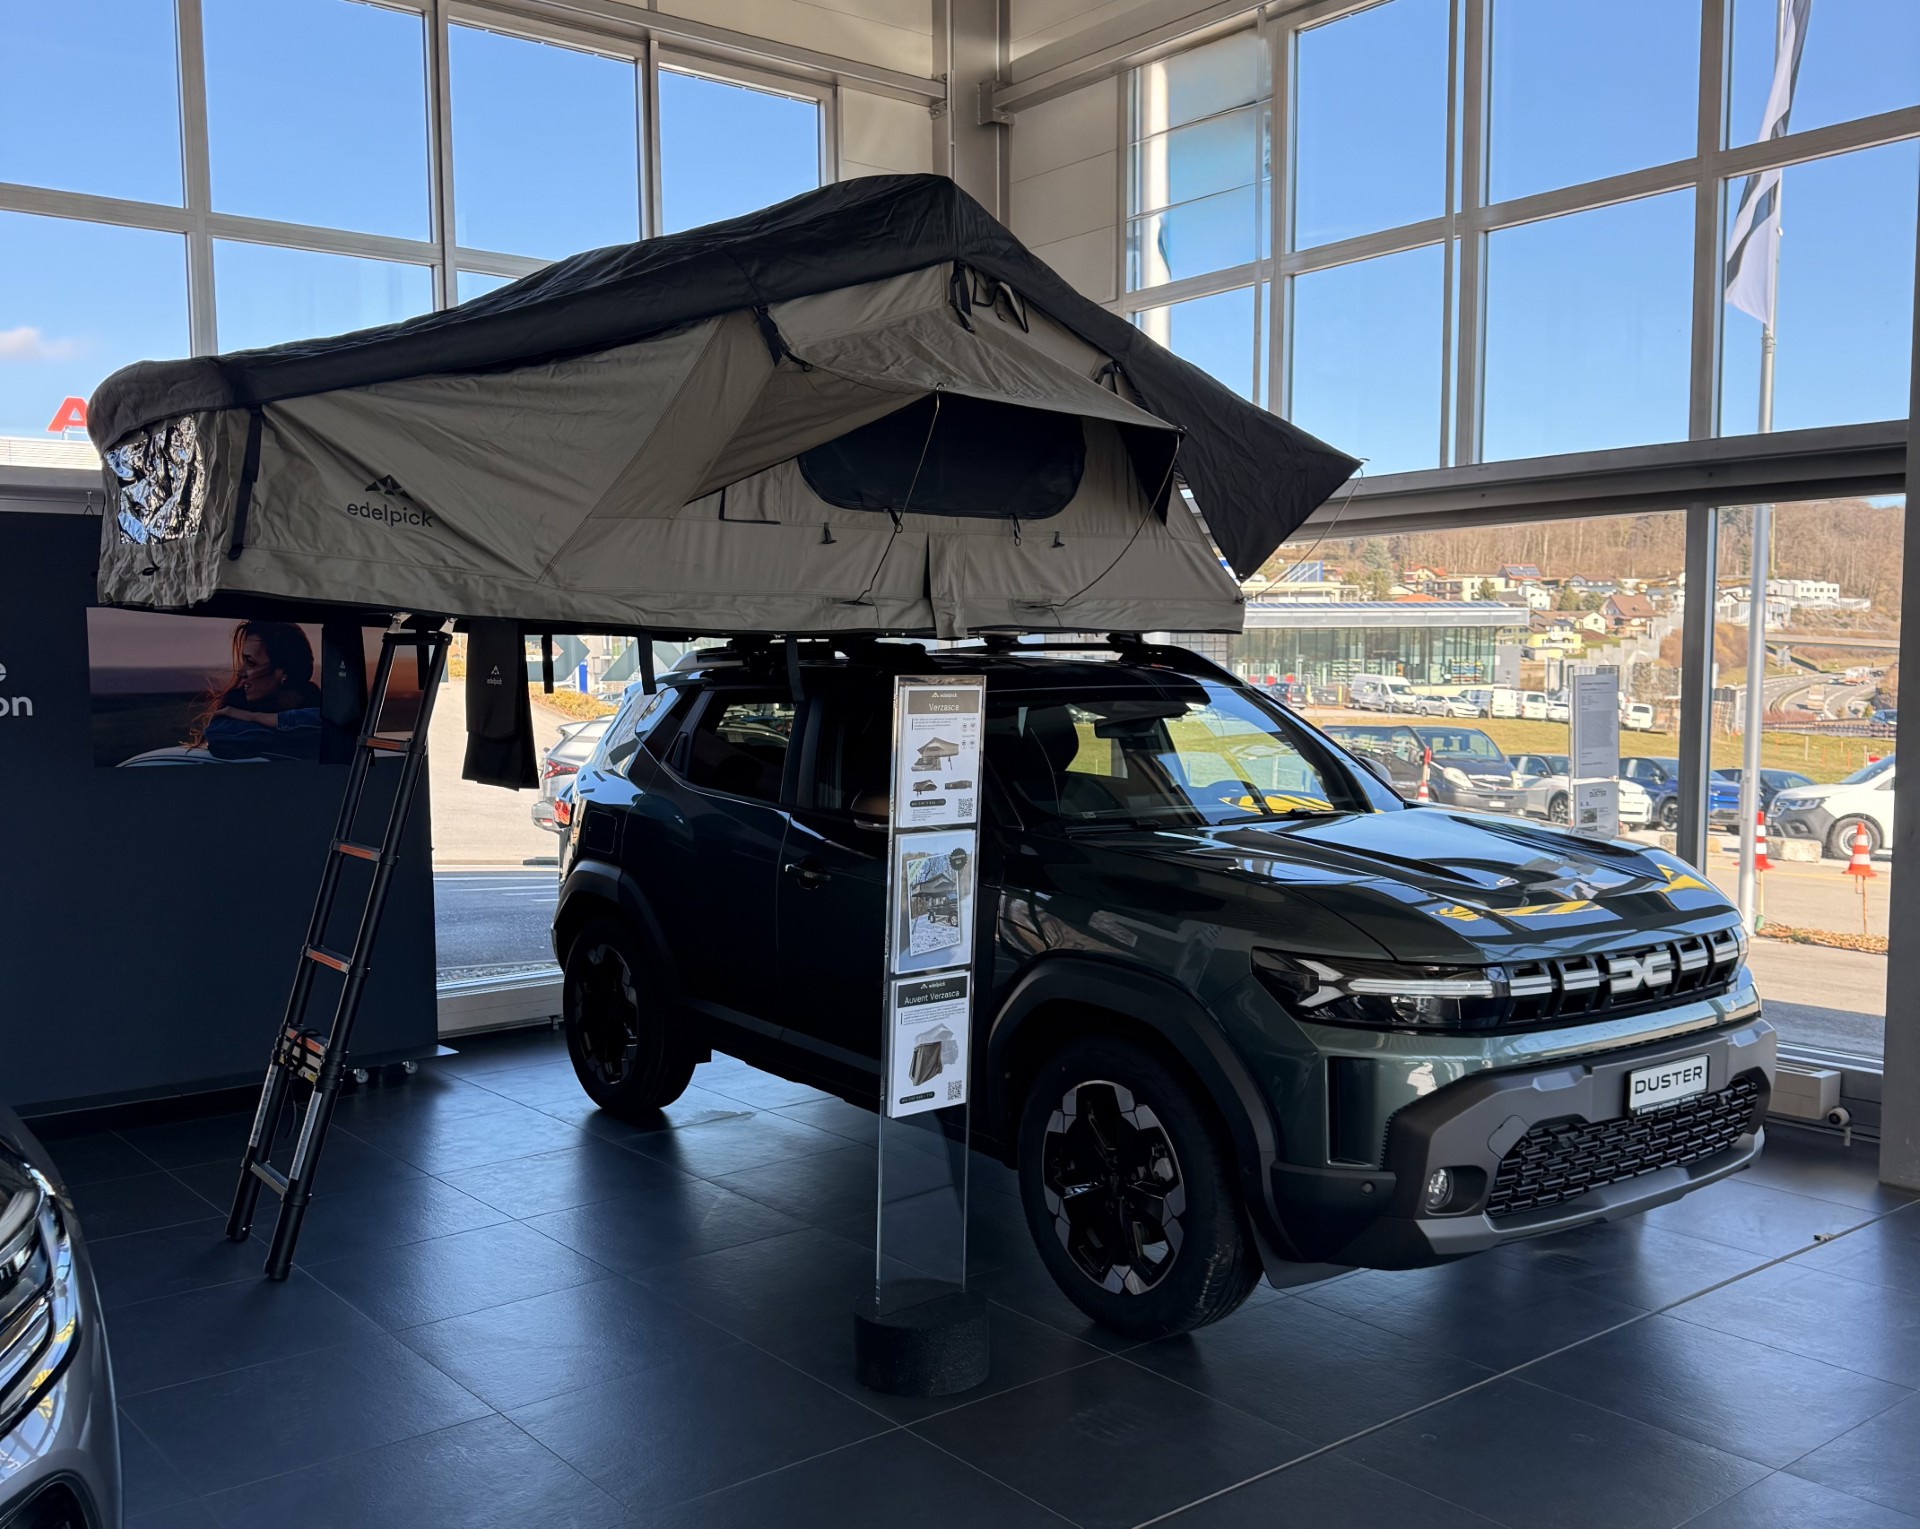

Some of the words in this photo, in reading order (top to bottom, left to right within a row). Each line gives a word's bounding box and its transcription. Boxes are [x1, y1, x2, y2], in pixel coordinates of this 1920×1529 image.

[347, 502, 433, 527] edelpick
[928, 703, 960, 712] Verzasca
[904, 995, 929, 1005] Auvent
[930, 990, 960, 1000] Verzasca
[1634, 1065, 1703, 1095] DUSTER
